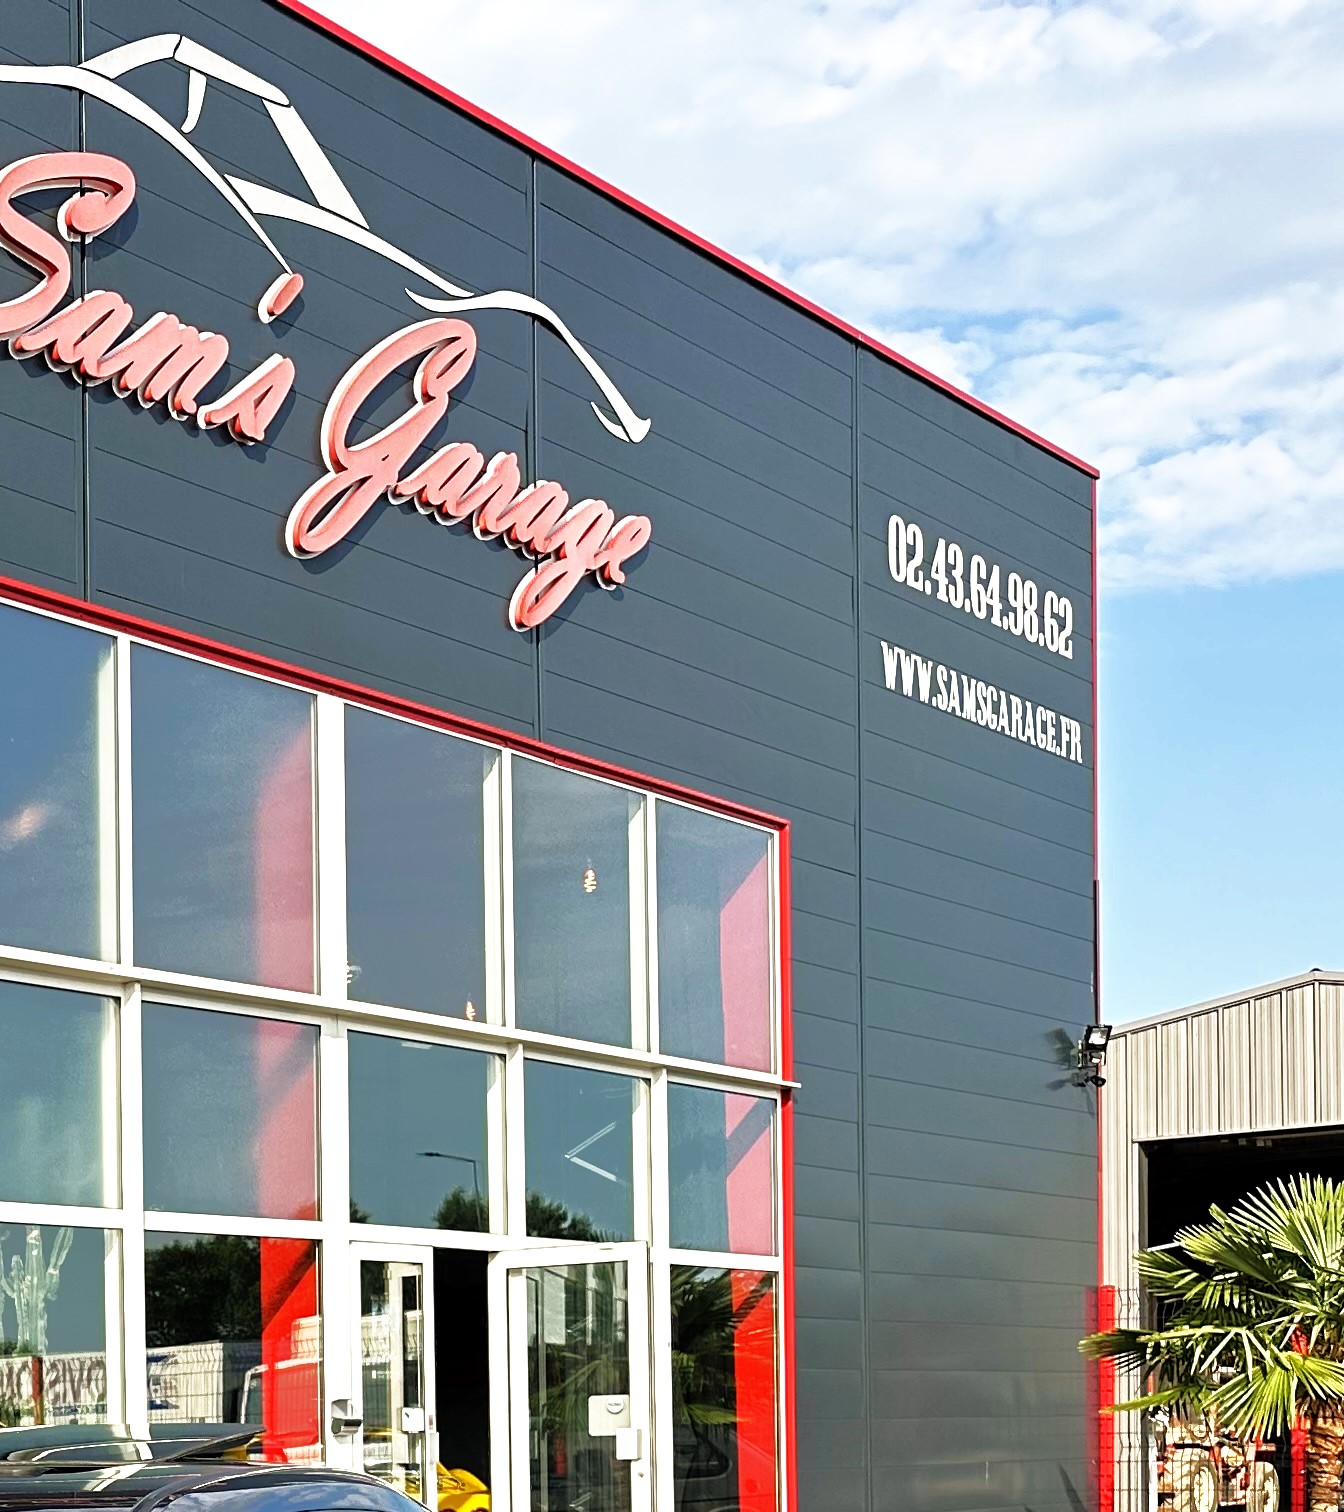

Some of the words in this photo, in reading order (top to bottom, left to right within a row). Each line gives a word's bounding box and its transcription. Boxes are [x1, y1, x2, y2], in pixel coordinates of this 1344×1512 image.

[284, 318, 653, 632] Garage
[887, 514, 1073, 660] 02.43.64.98.62
[880, 640, 1083, 764] WWW.SAMSGARAGE.FR
